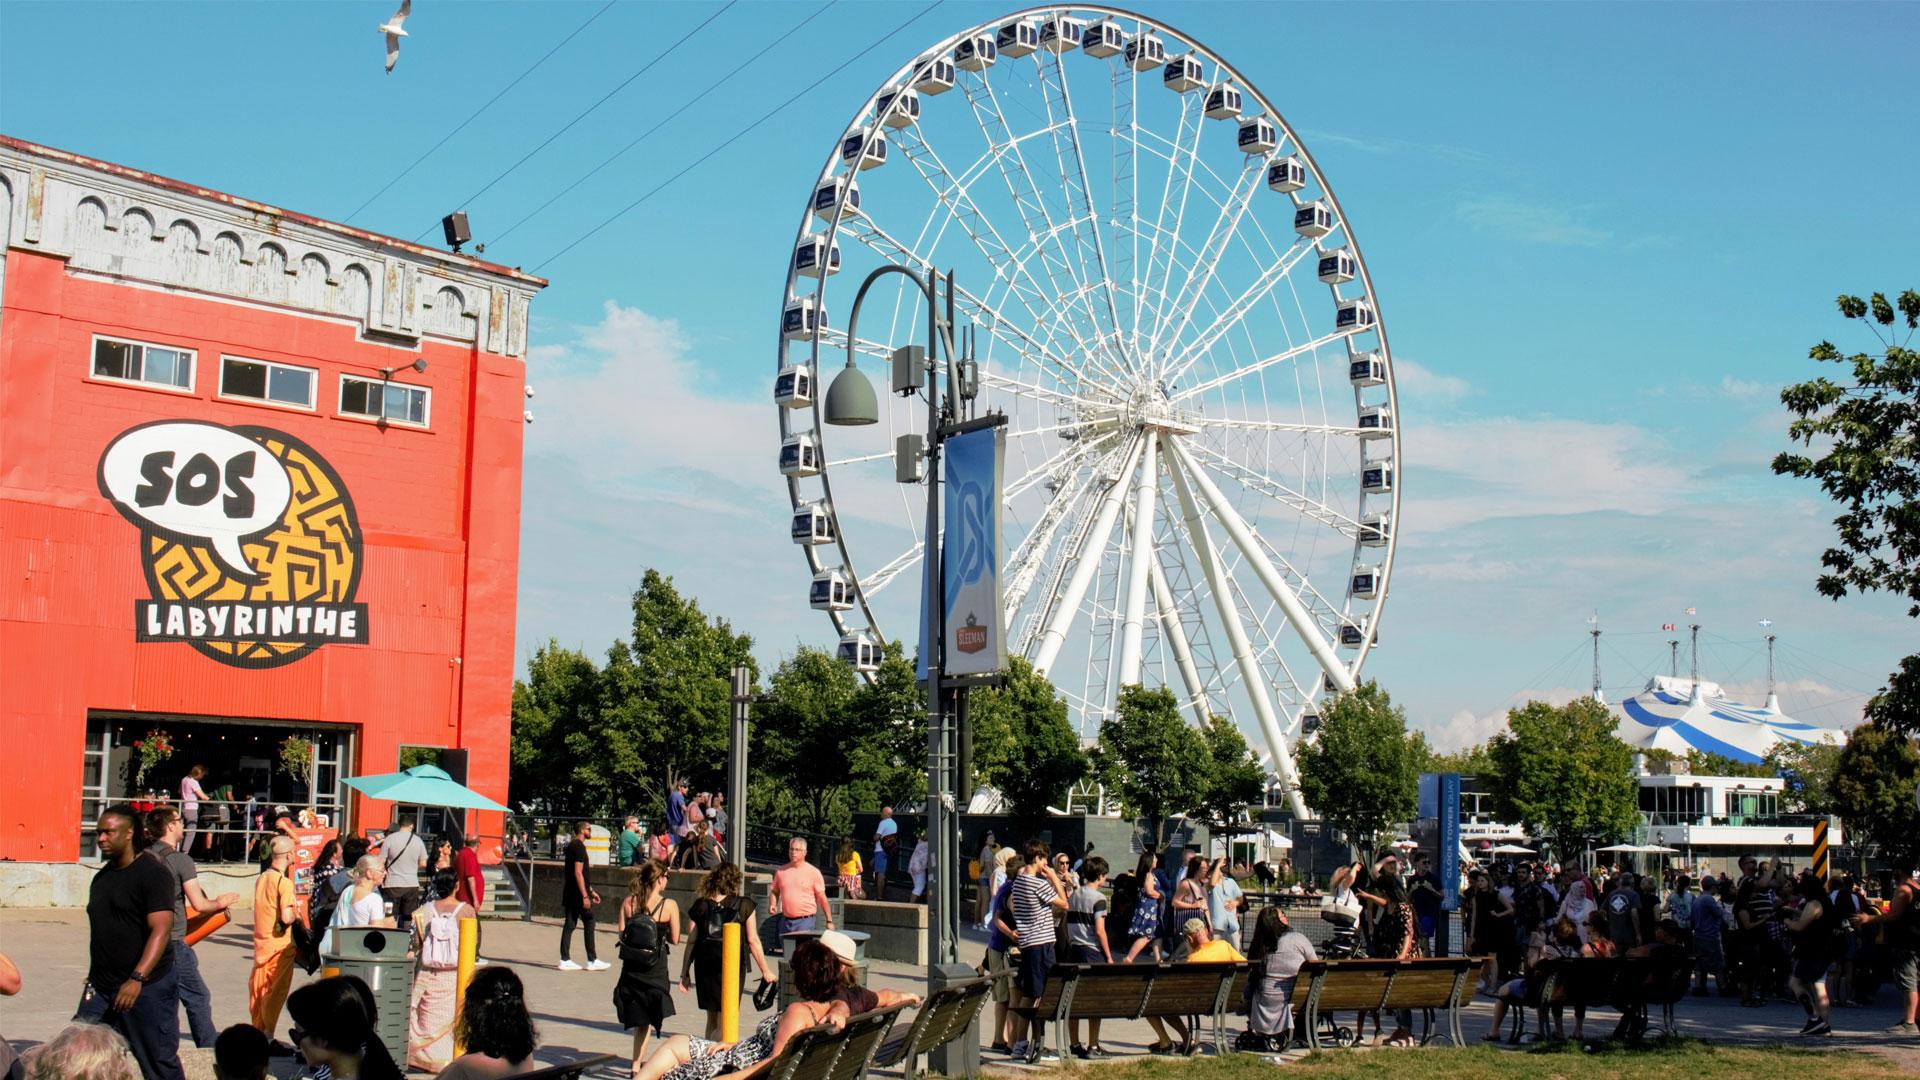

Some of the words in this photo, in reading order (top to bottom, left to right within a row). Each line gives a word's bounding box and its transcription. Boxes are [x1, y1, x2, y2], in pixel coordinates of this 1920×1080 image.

[134, 450, 256, 519] SOS
[147, 603, 357, 638] LABYRINTHE
[958, 631, 985, 645] SLEEMAN
